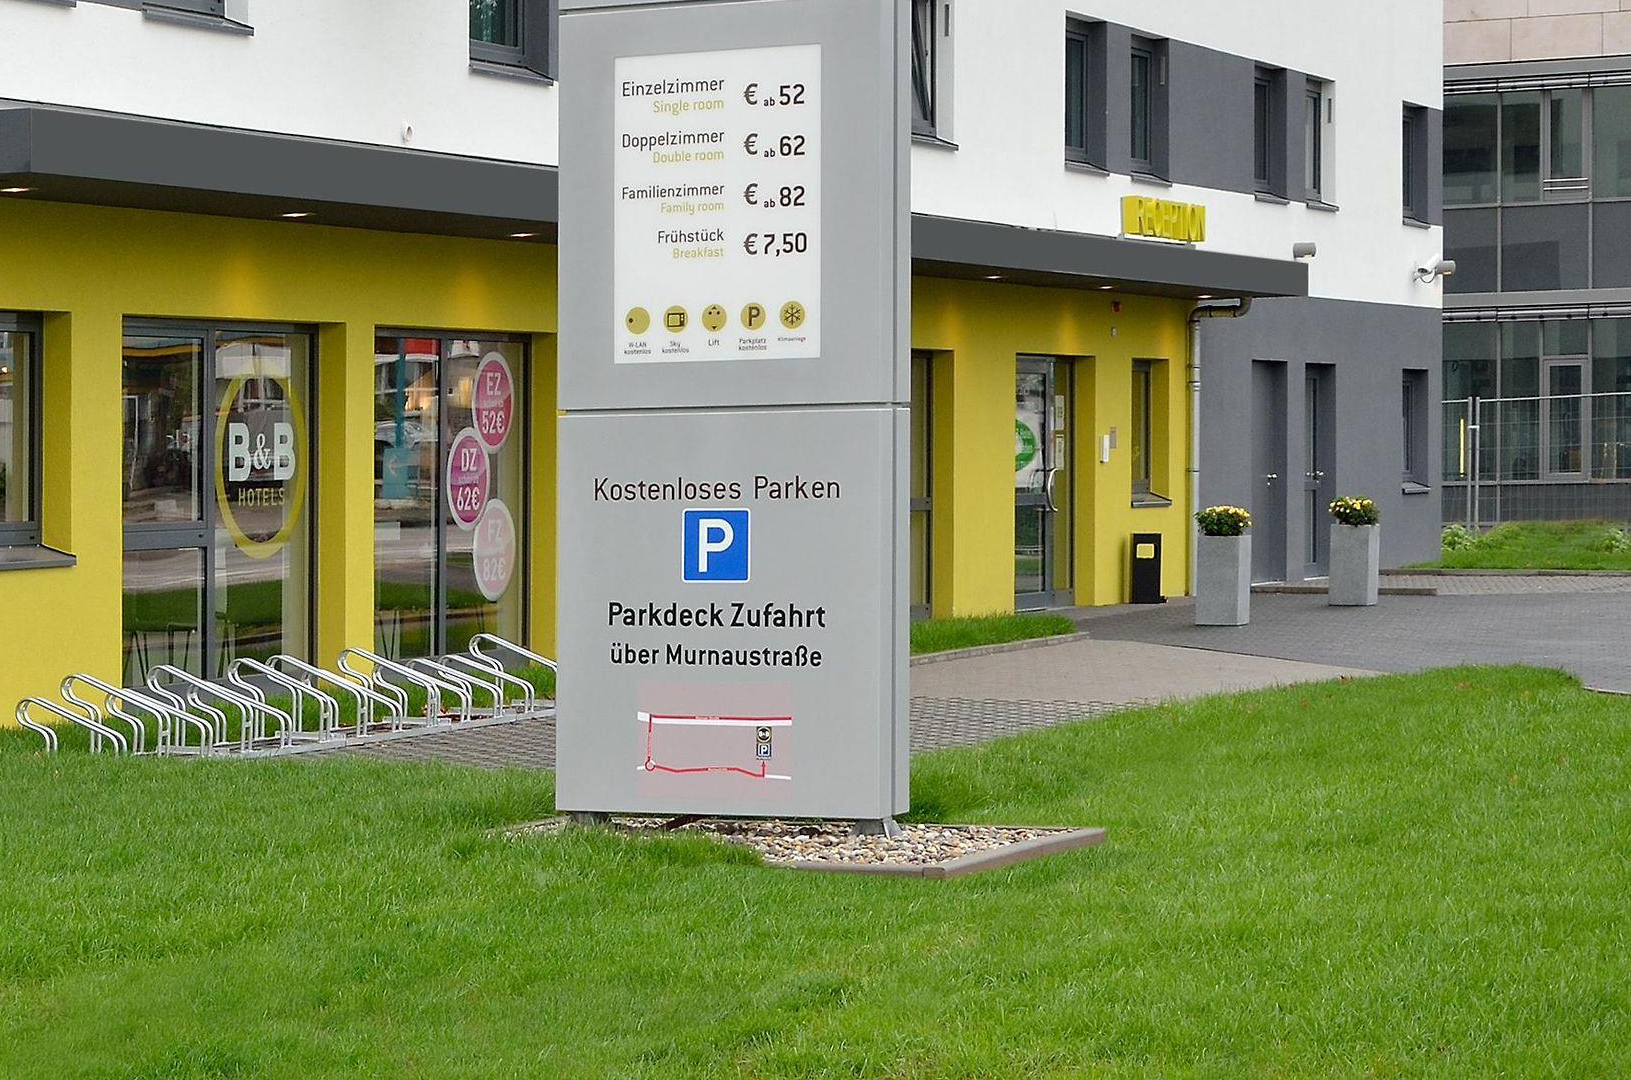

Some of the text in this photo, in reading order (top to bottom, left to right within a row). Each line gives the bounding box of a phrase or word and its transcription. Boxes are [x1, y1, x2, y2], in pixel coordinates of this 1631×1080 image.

[622, 78, 725, 97] Einzelzimmer
[763, 97, 775, 107] ab
[779, 84, 805, 106] 52
[653, 99, 724, 116] Single room
[622, 130, 725, 151] Doppelzimmer
[764, 147, 776, 158] ab
[779, 135, 806, 156] 62
[653, 150, 724, 163] Double room
[622, 183, 725, 200] Familienzimmer
[763, 198, 776, 208] ab
[779, 186, 806, 207] 82
[660, 202, 724, 215] Family room
[657, 228, 725, 244] Frühstück
[673, 247, 724, 259] Breakfast
[486, 372, 501, 395] EZ
[482, 410, 505, 434] 52€
[229, 423, 296, 481] B&B
[461, 448, 477, 472] DZ
[238, 488, 286, 507] HOTELS
[456, 487, 480, 511] 62€
[594, 475, 840, 501] Kostenloses Parken
[698, 519, 734, 572] P
[608, 602, 826, 628] Parkdeck Zufahrt
[610, 643, 822, 667] über Murnaustraße
